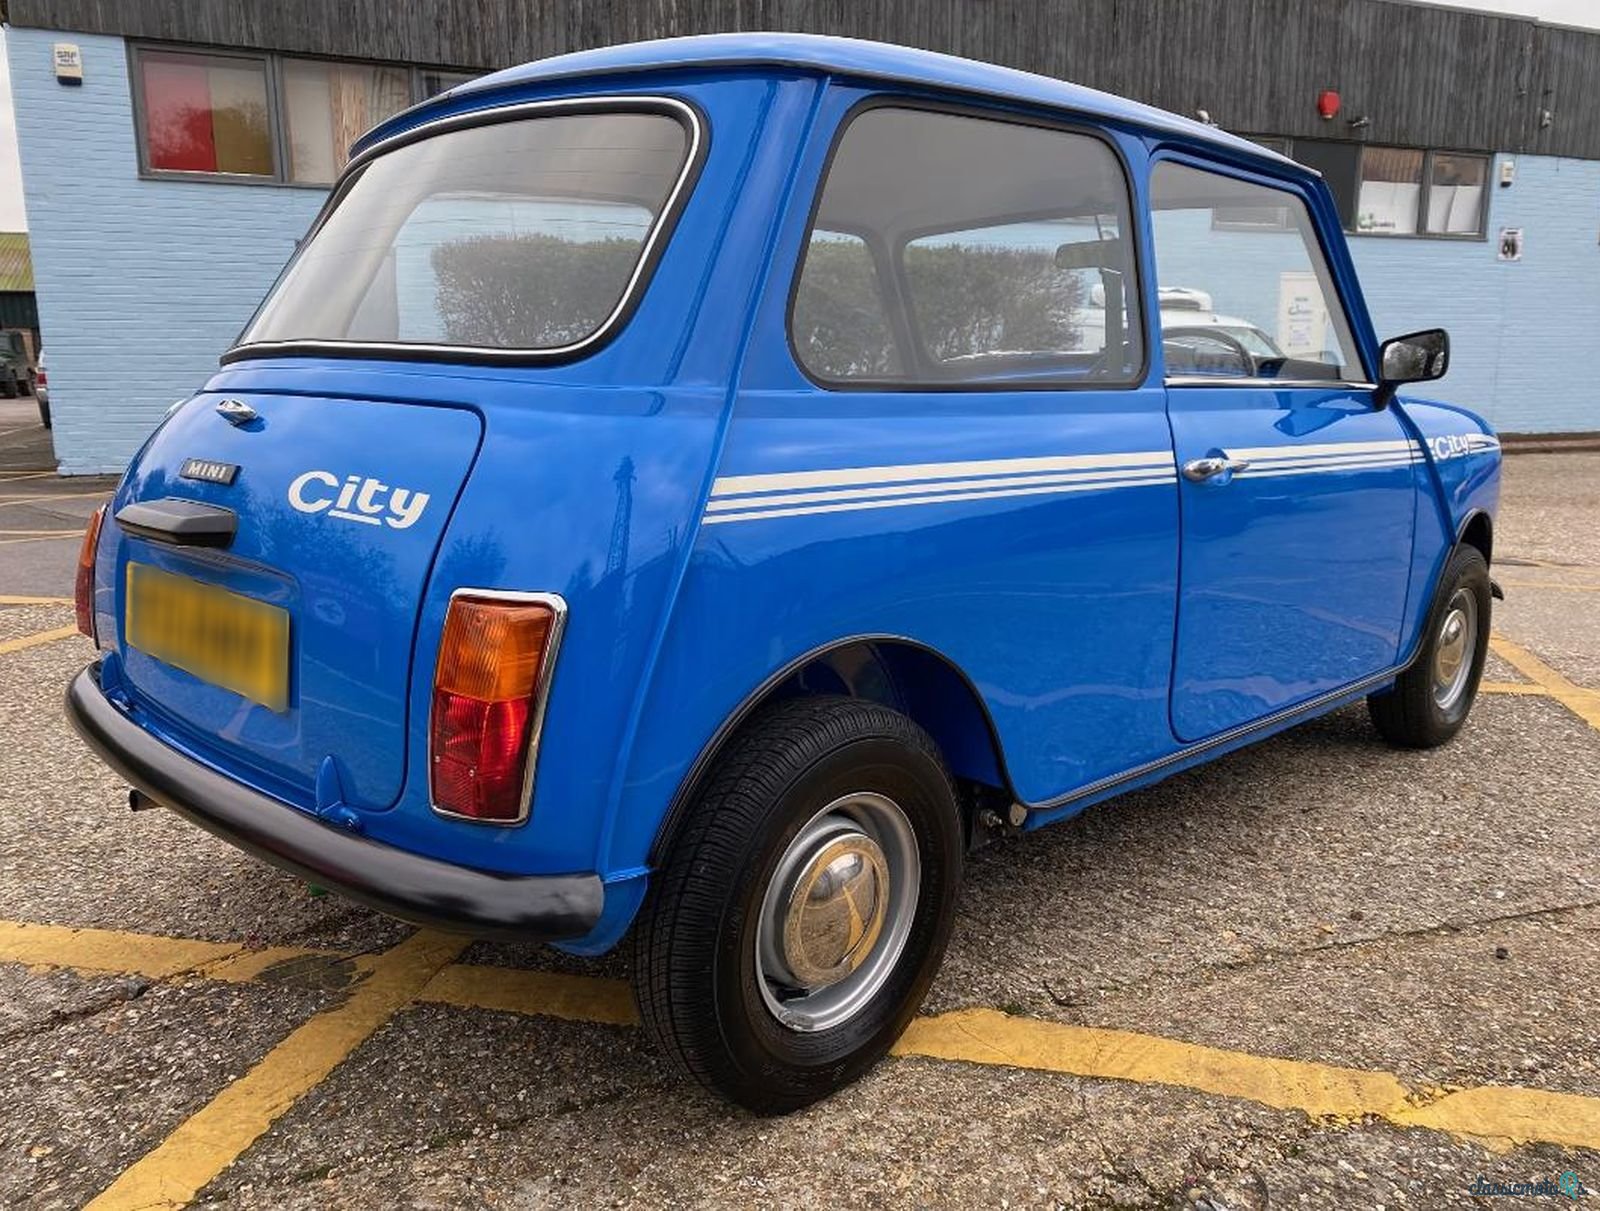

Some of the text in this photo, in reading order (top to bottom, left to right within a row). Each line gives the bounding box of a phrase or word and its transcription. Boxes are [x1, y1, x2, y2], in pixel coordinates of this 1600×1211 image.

[1435, 434, 1469, 460] City
[187, 462, 226, 479] MINI
[287, 470, 430, 529] City
